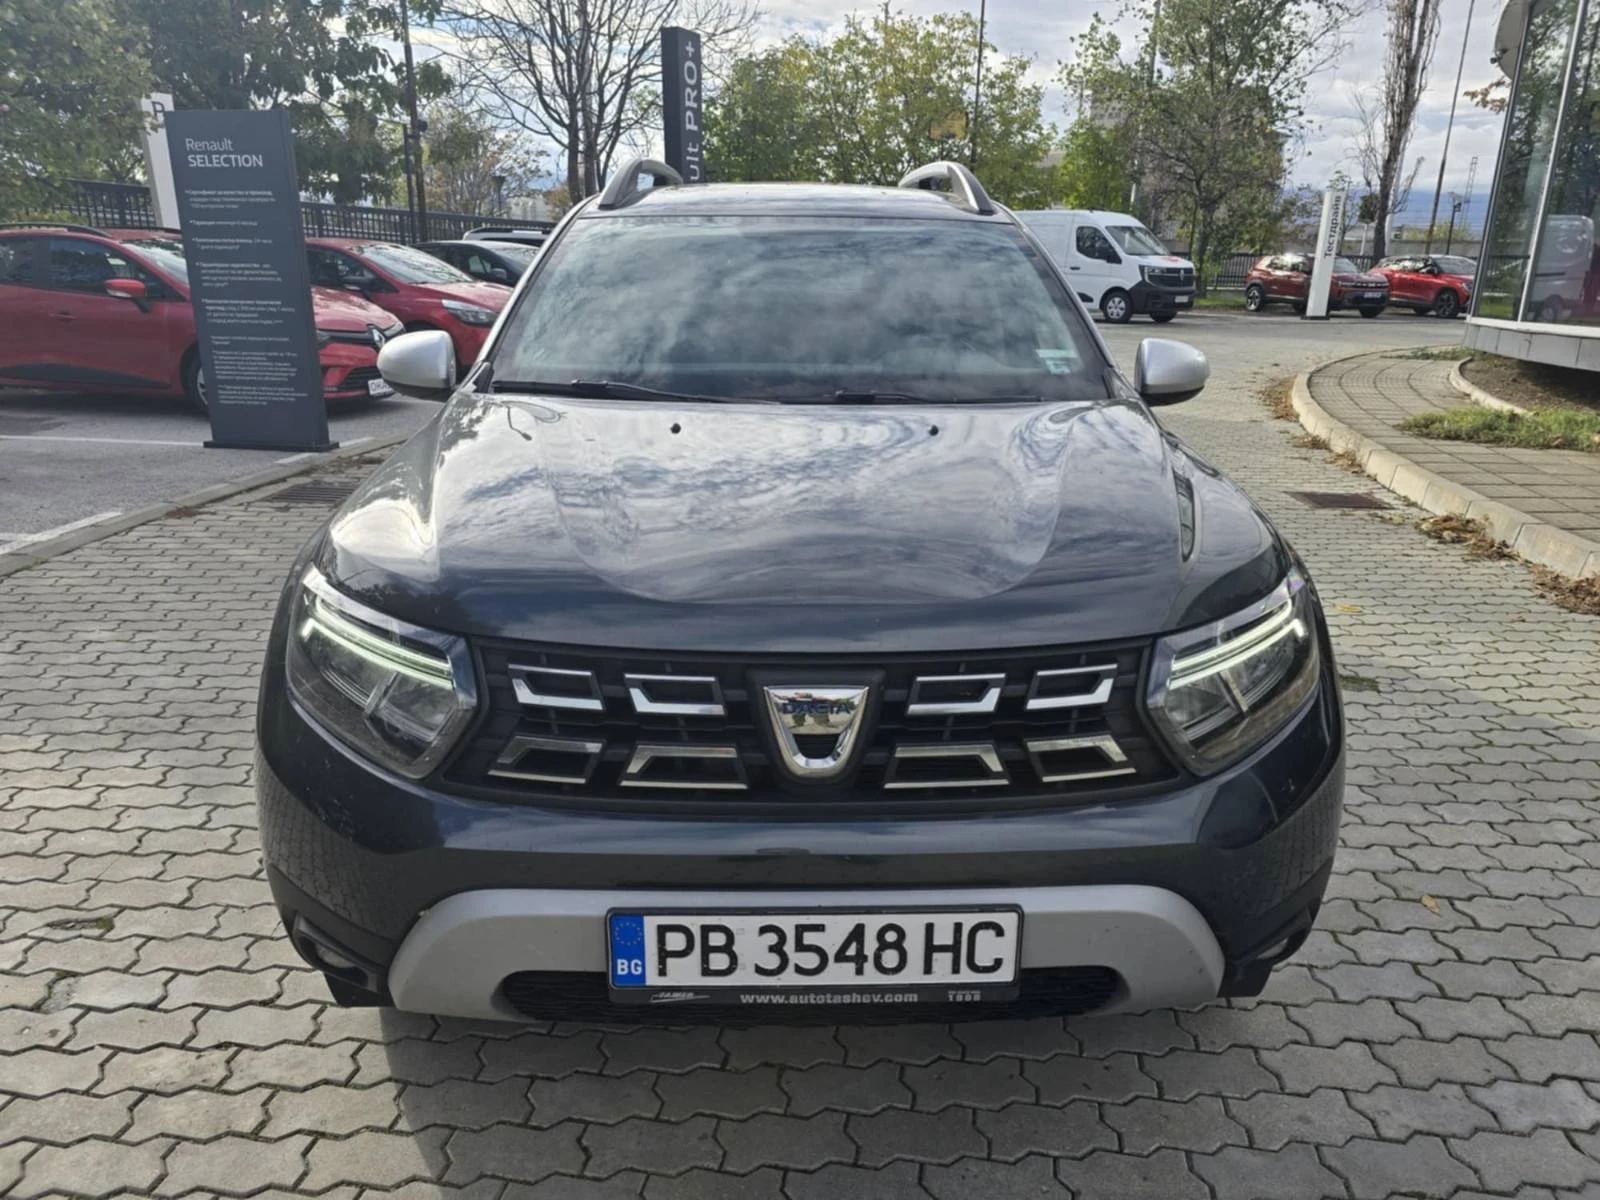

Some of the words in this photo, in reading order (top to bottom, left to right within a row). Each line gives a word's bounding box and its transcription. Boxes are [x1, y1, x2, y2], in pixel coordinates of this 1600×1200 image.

[684, 40, 699, 132] PRO+
[185, 137, 235, 152] Renault
[187, 154, 264, 168] SELECTION
[782, 702, 850, 715] DACIA
[656, 922, 739, 977] PB
[753, 922, 908, 977] 3548
[922, 920, 1006, 976] HC
[616, 958, 643, 976] BG
[739, 992, 919, 1004] www.autotashev.com
